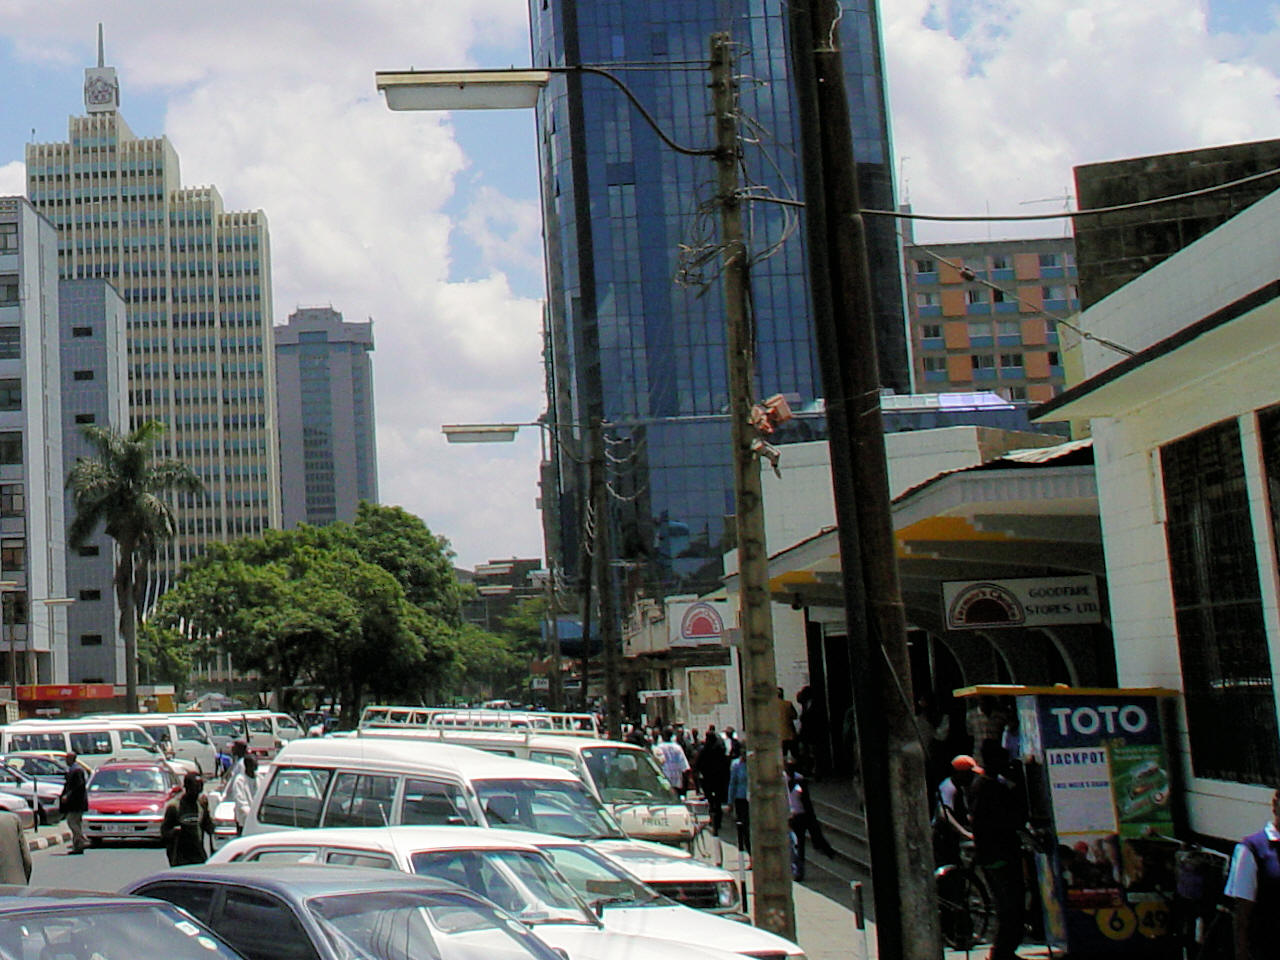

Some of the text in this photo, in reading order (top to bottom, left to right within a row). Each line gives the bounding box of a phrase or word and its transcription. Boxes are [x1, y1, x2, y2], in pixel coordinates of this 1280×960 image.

[1025, 603, 1071, 615] STORES
[1050, 704, 1148, 736] TOTO
[1050, 751, 1105, 765] JACKPOT
[1109, 909, 1125, 932] 6
